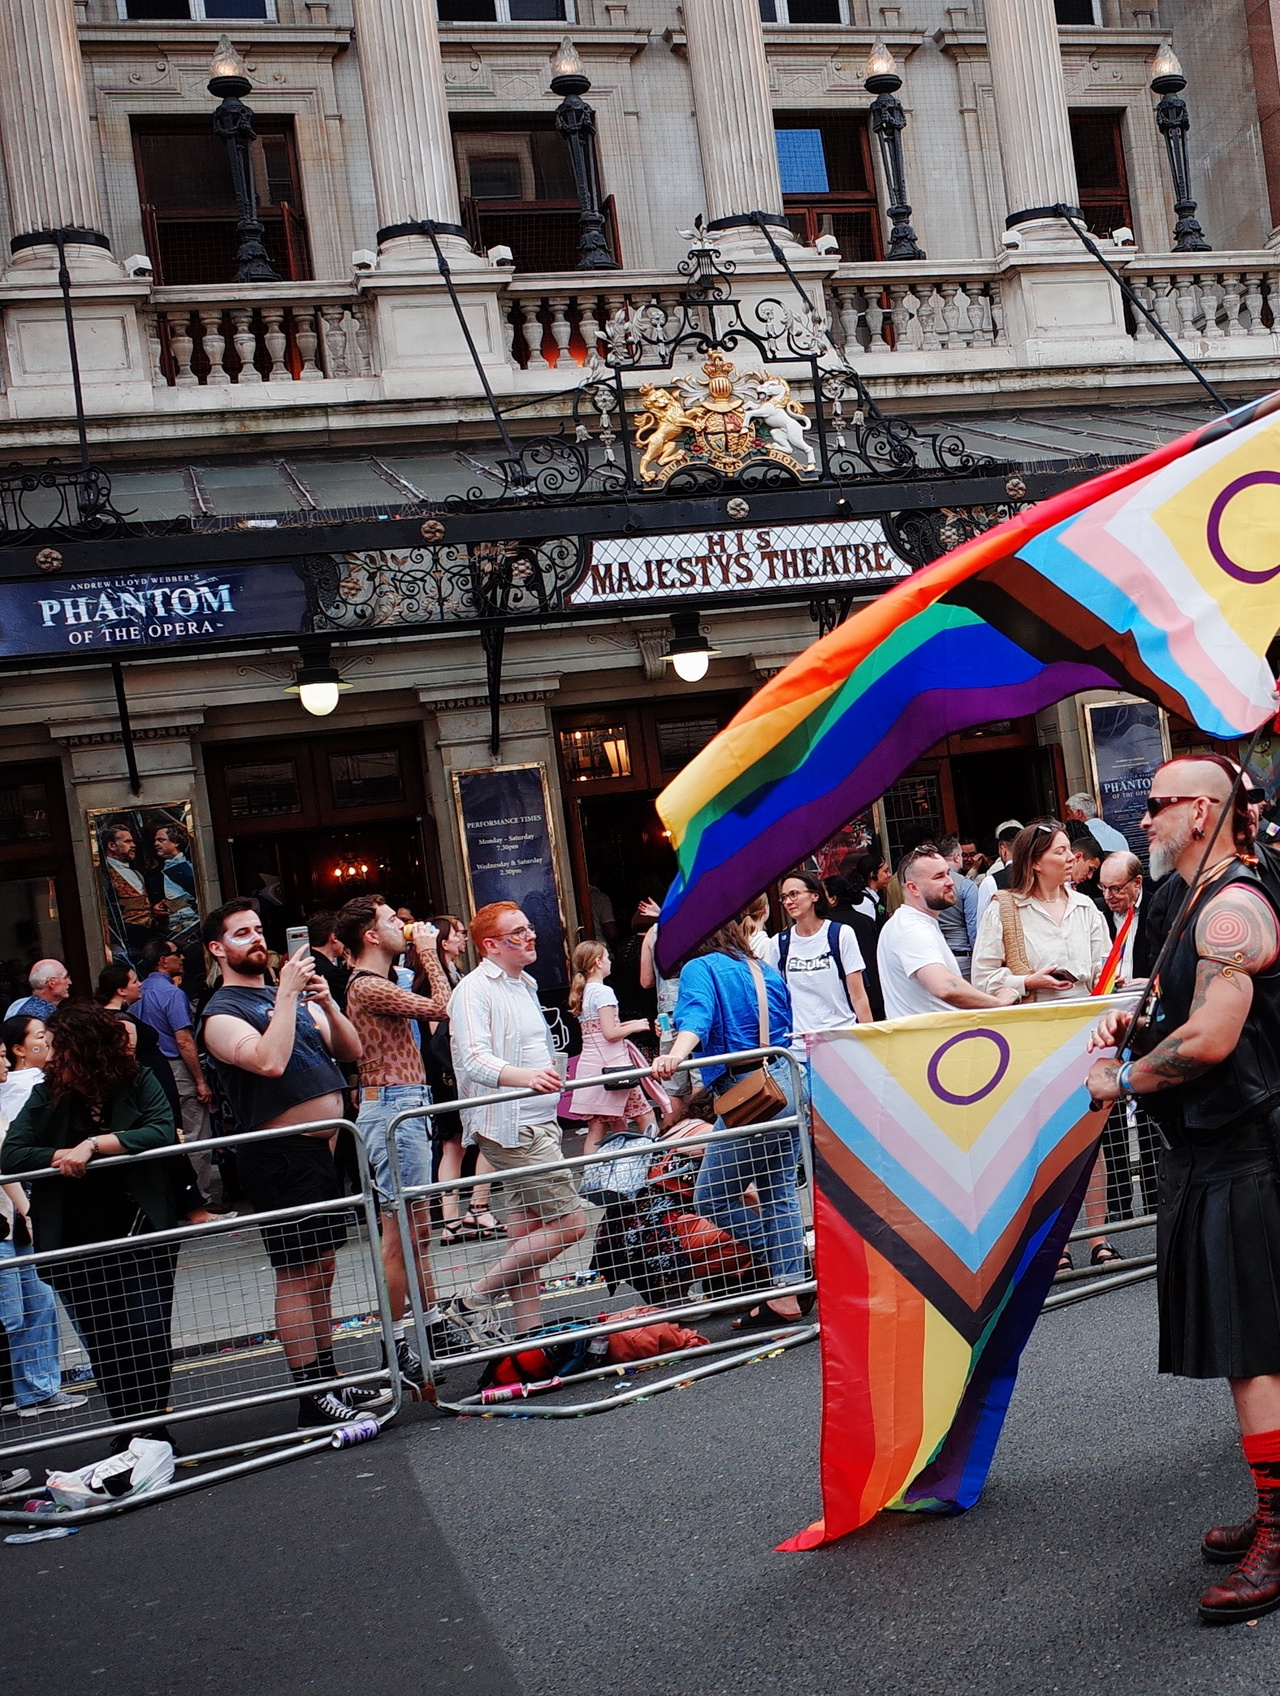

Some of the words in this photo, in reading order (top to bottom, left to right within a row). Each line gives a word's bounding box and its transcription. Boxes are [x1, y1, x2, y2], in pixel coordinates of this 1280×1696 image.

[769, 451, 803, 472] DROIT
[707, 530, 771, 554] HIS
[590, 551, 754, 596] MAJESTYS
[760, 541, 893, 580] THEATRE
[69, 580, 112, 591] ANDREW
[115, 578, 147, 588] LLOYD
[150, 574, 200, 584] WEBBER'S
[37, 583, 237, 628] PHANTOM
[68, 630, 94, 645] OF
[101, 626, 142, 642] THE
[148, 621, 215, 638] OPERA
[1104, 777, 1155, 794] PHANTO
[467, 818, 520, 829] PERFORMANCE
[520, 814, 542, 823] TIMES
[478, 836, 503, 845] Monday
[508, 833, 535, 843] Saturday
[476, 860, 510, 870] Wednesday
[517, 856, 544, 867] Saturday
